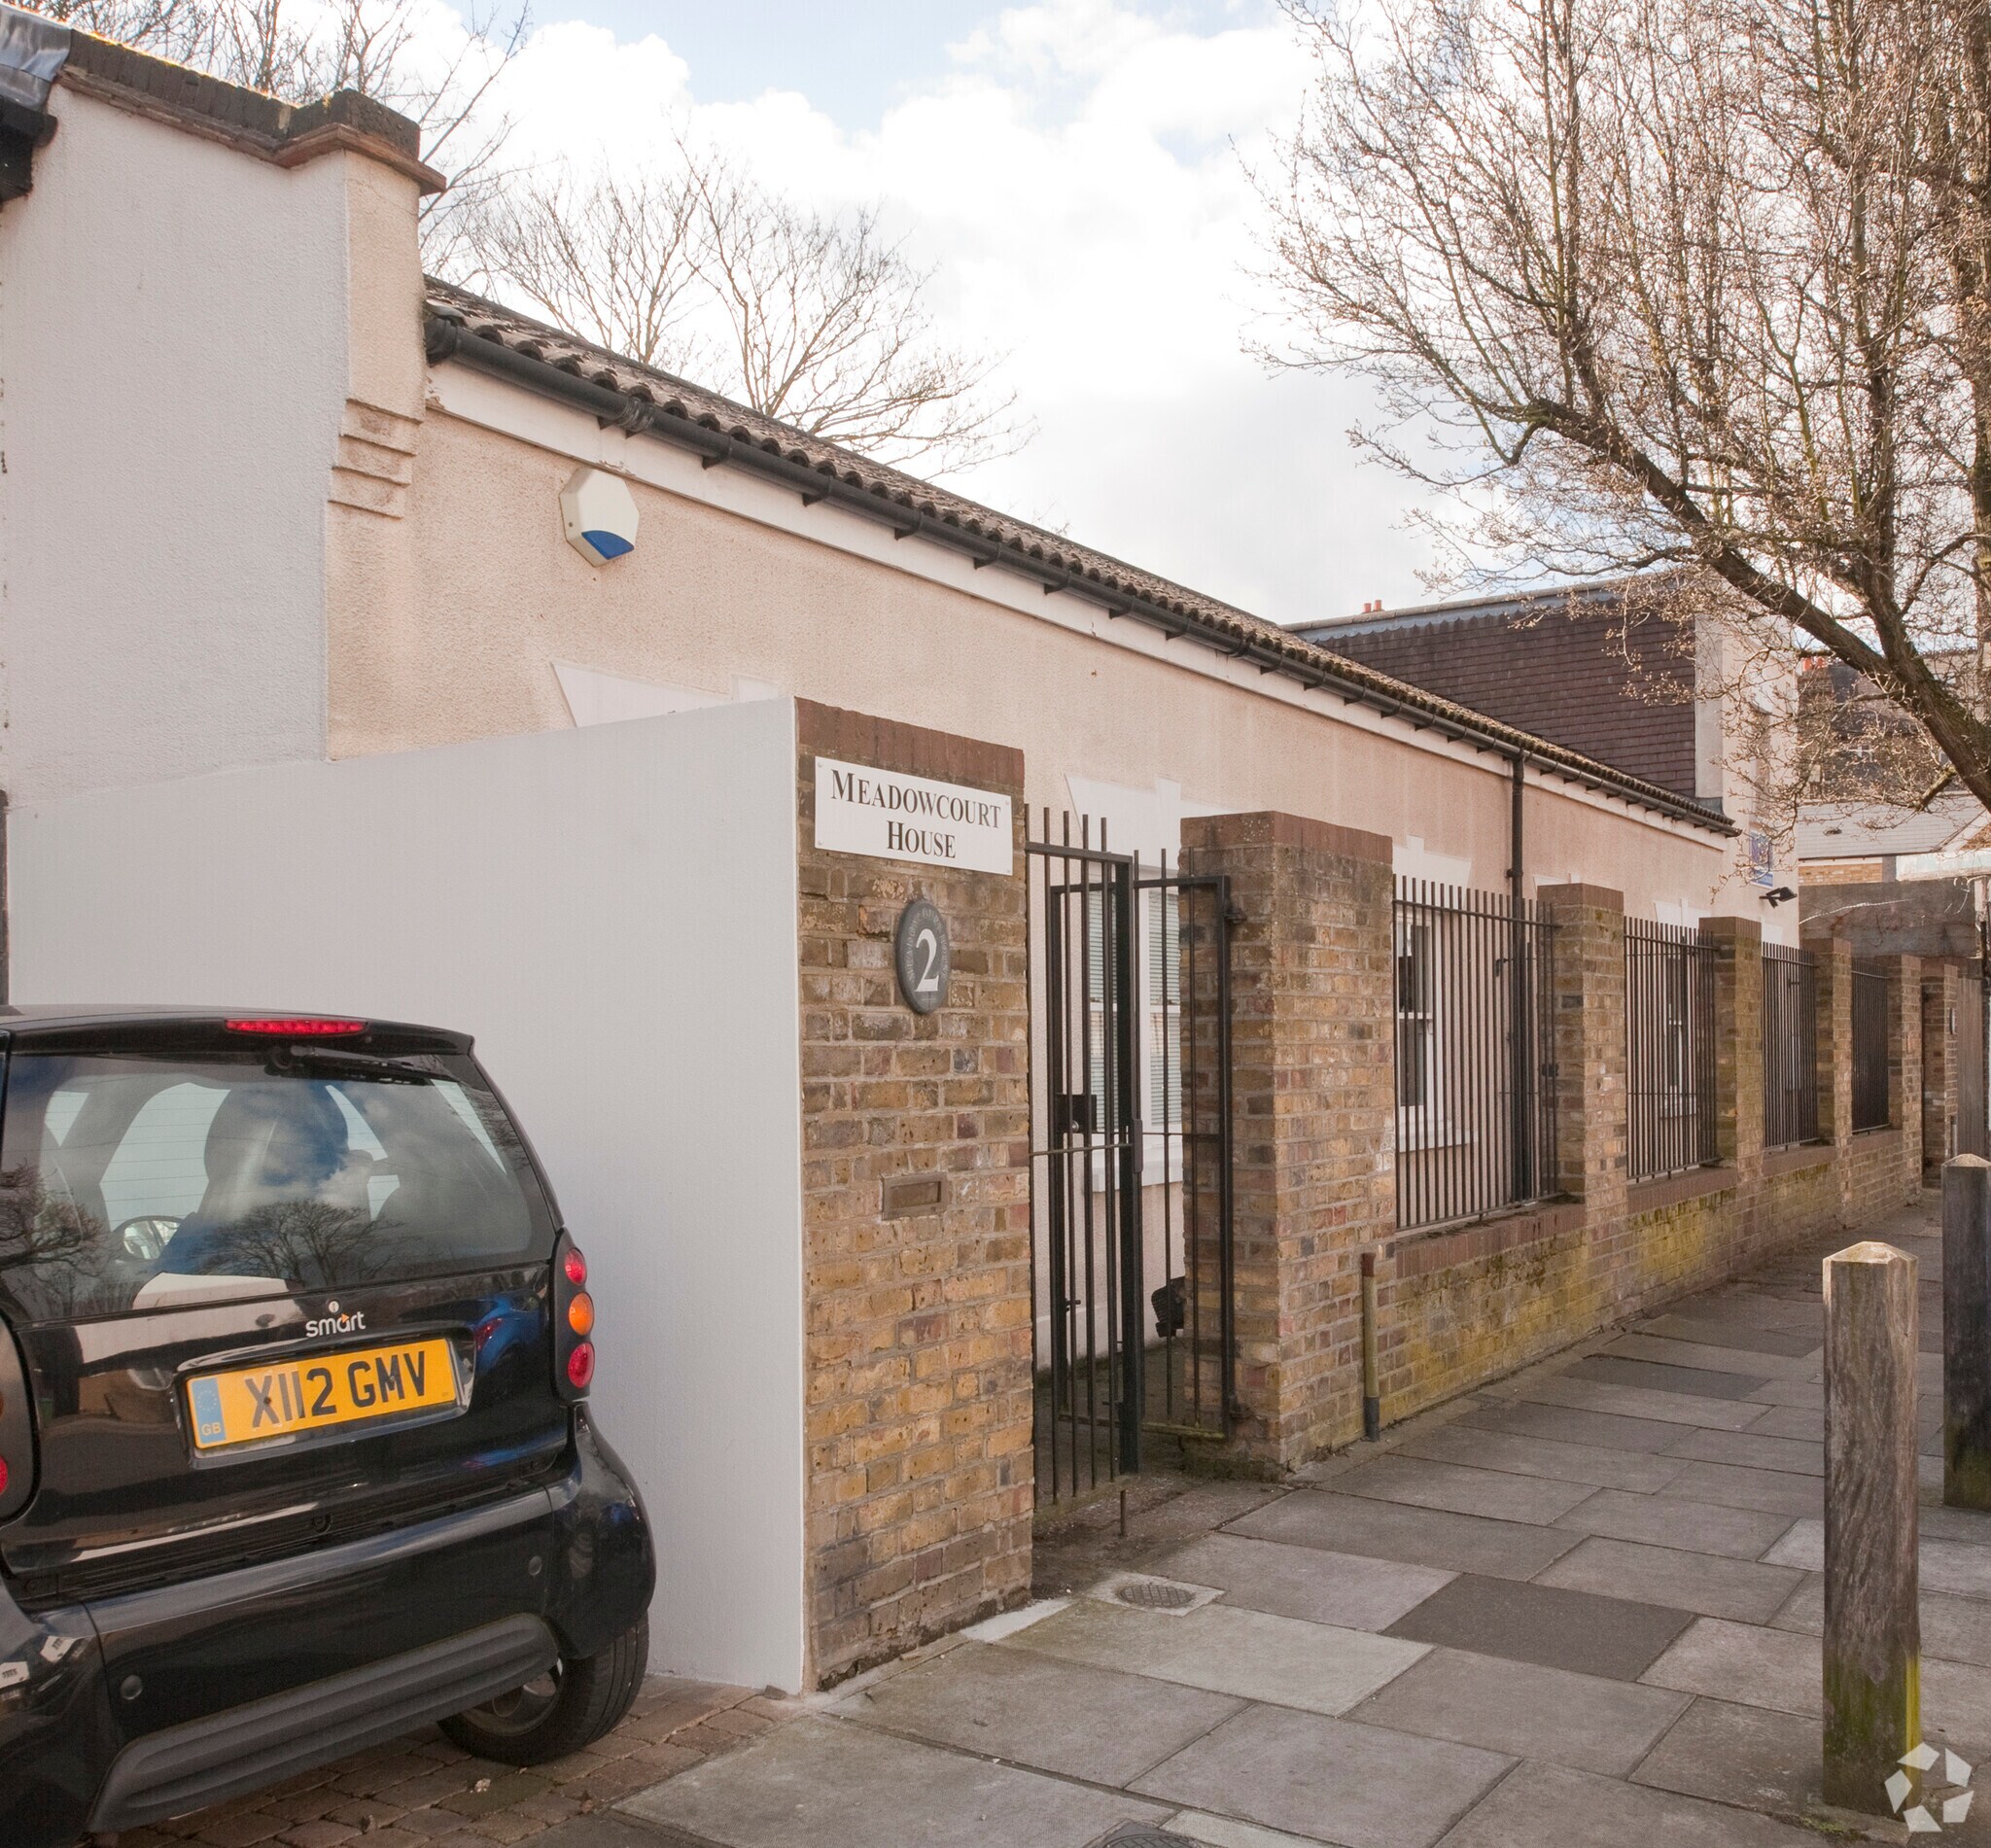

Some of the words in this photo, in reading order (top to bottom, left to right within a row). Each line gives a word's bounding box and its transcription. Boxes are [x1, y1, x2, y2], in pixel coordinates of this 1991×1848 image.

[830, 769, 1001, 828] MEADOWCOURT
[887, 820, 957, 859] HOUSE
[915, 928, 940, 992] 2
[305, 1310, 367, 1338] smart
[245, 1367, 337, 1429] X112
[347, 1350, 426, 1408] GMV
[200, 1420, 222, 1437] GB
